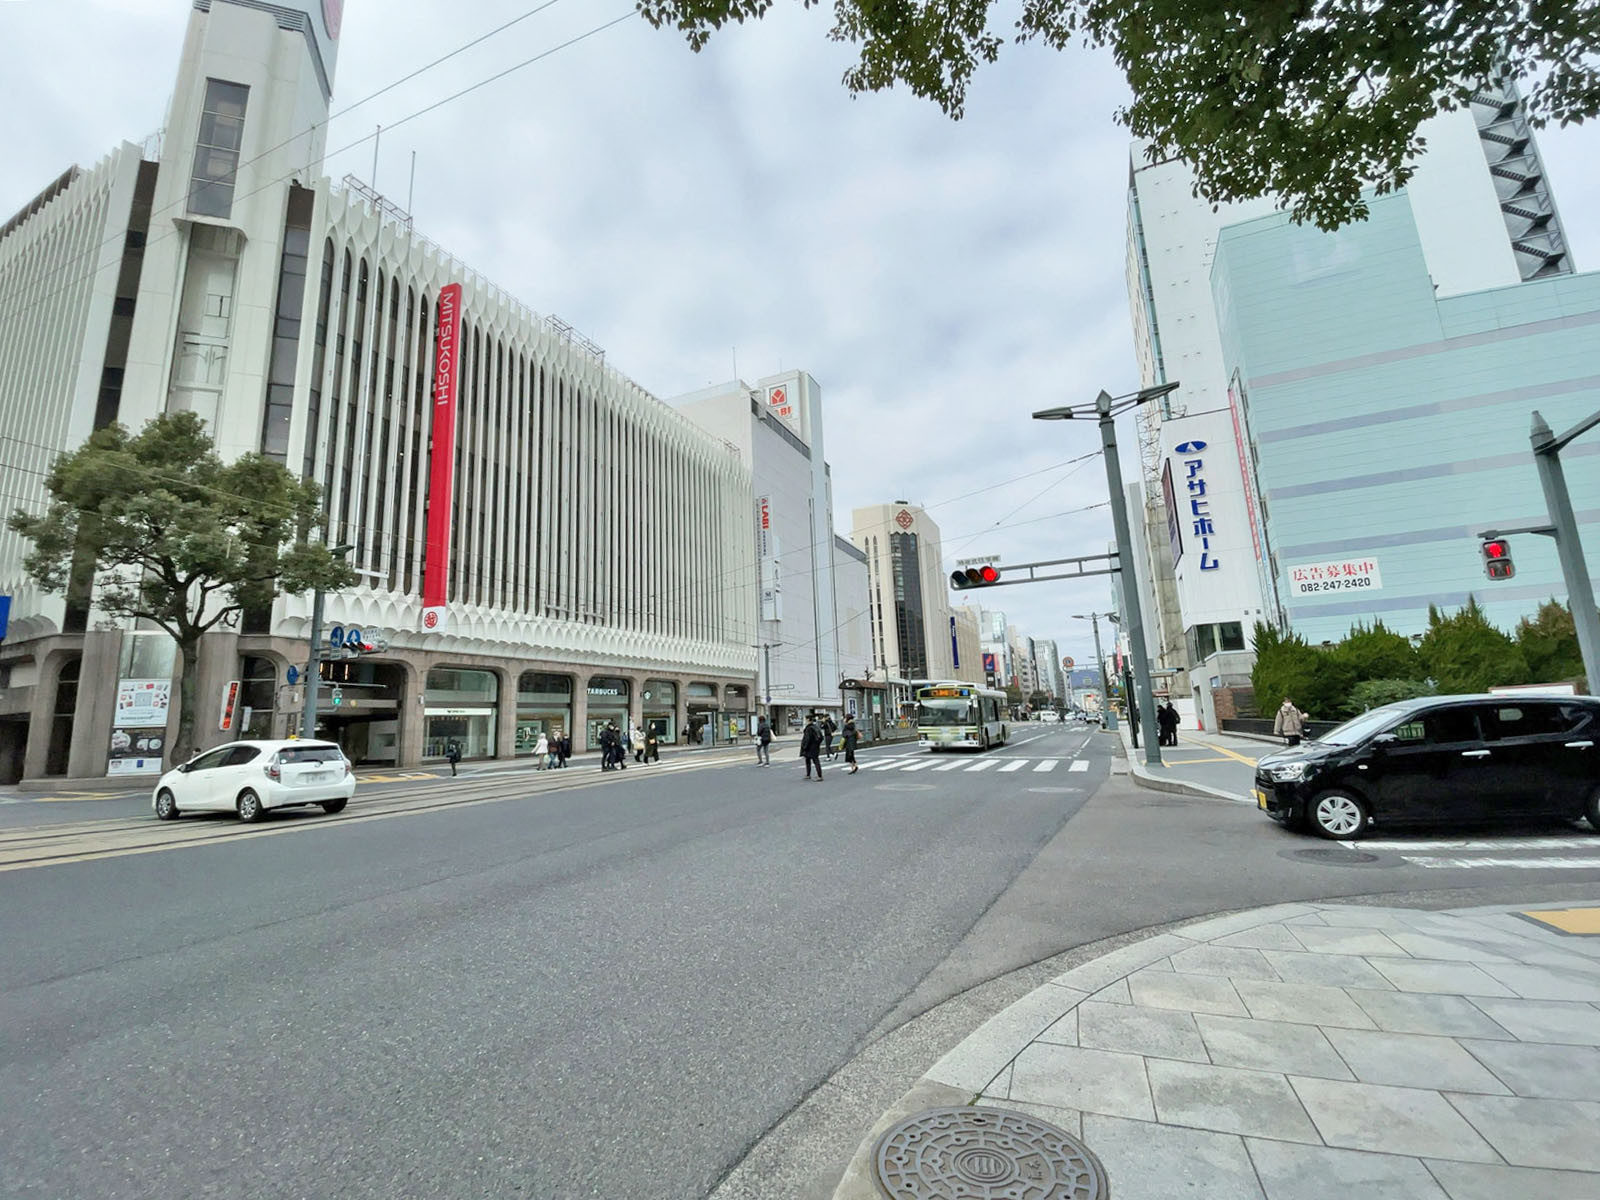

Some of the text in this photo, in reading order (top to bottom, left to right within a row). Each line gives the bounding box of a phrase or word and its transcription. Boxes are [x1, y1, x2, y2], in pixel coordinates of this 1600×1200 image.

[437, 292, 454, 405] MITSUKOSHI
[1184, 458, 1219, 570] アサヒホーム
[1293, 561, 1374, 581] 広告募集中
[1300, 577, 1371, 593] 082-247-2420
[587, 688, 618, 696] TARBUCKS
